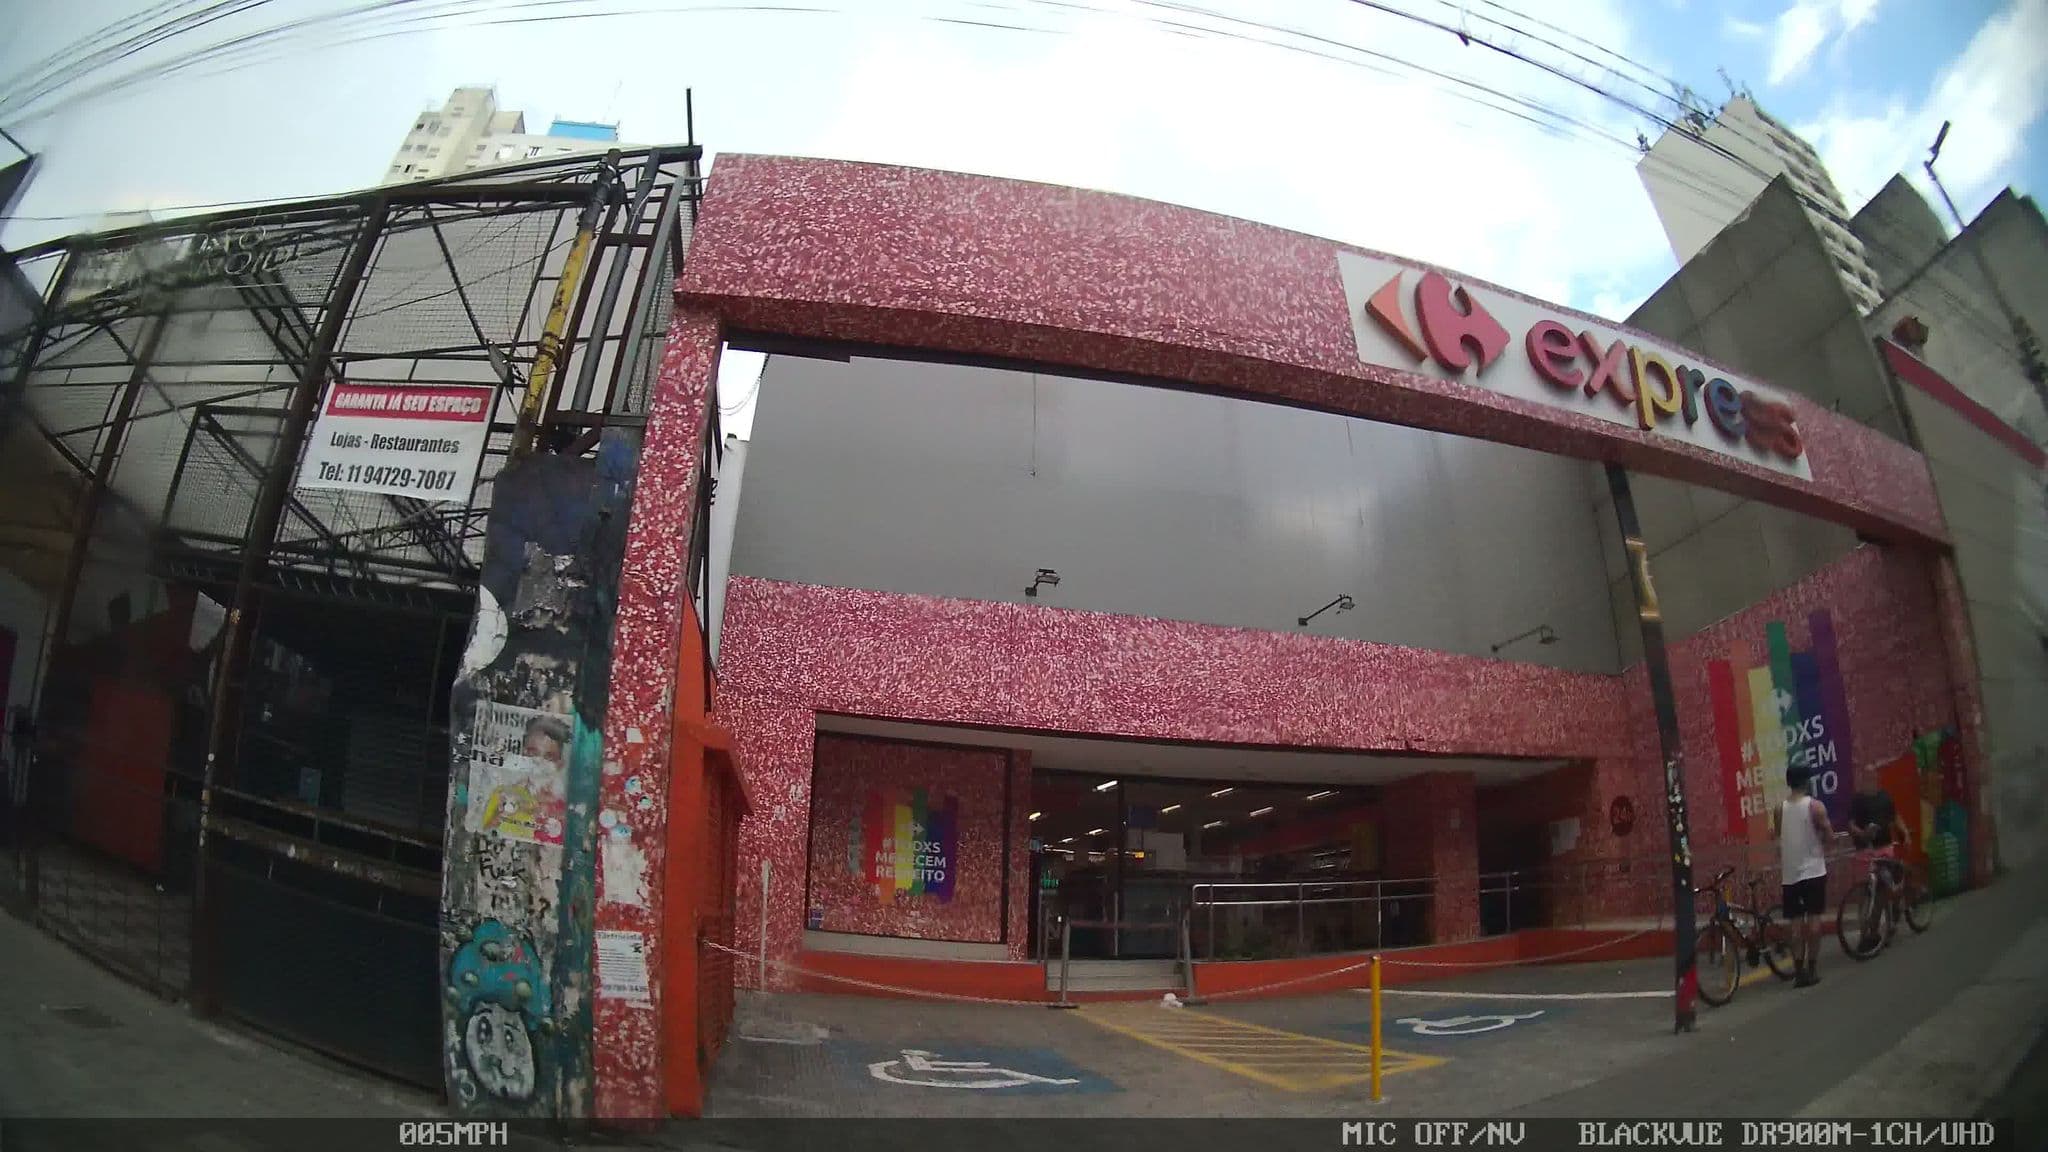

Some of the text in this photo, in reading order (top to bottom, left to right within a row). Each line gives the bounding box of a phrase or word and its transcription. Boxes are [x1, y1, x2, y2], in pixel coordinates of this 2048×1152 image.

[1525, 320, 1803, 458] express
[334, 392, 482, 416] GARANTA JÁ SEU ESPAÇO
[330, 431, 365, 449] Lojas
[370, 433, 460, 454] Restaurantes
[318, 461, 457, 491] Tel: 11 94729-7087
[1740, 714, 1825, 762] #DXS
[1735, 740, 1838, 791] MECEM
[875, 850, 947, 869] MECEM
[875, 864, 946, 882] REEITO
